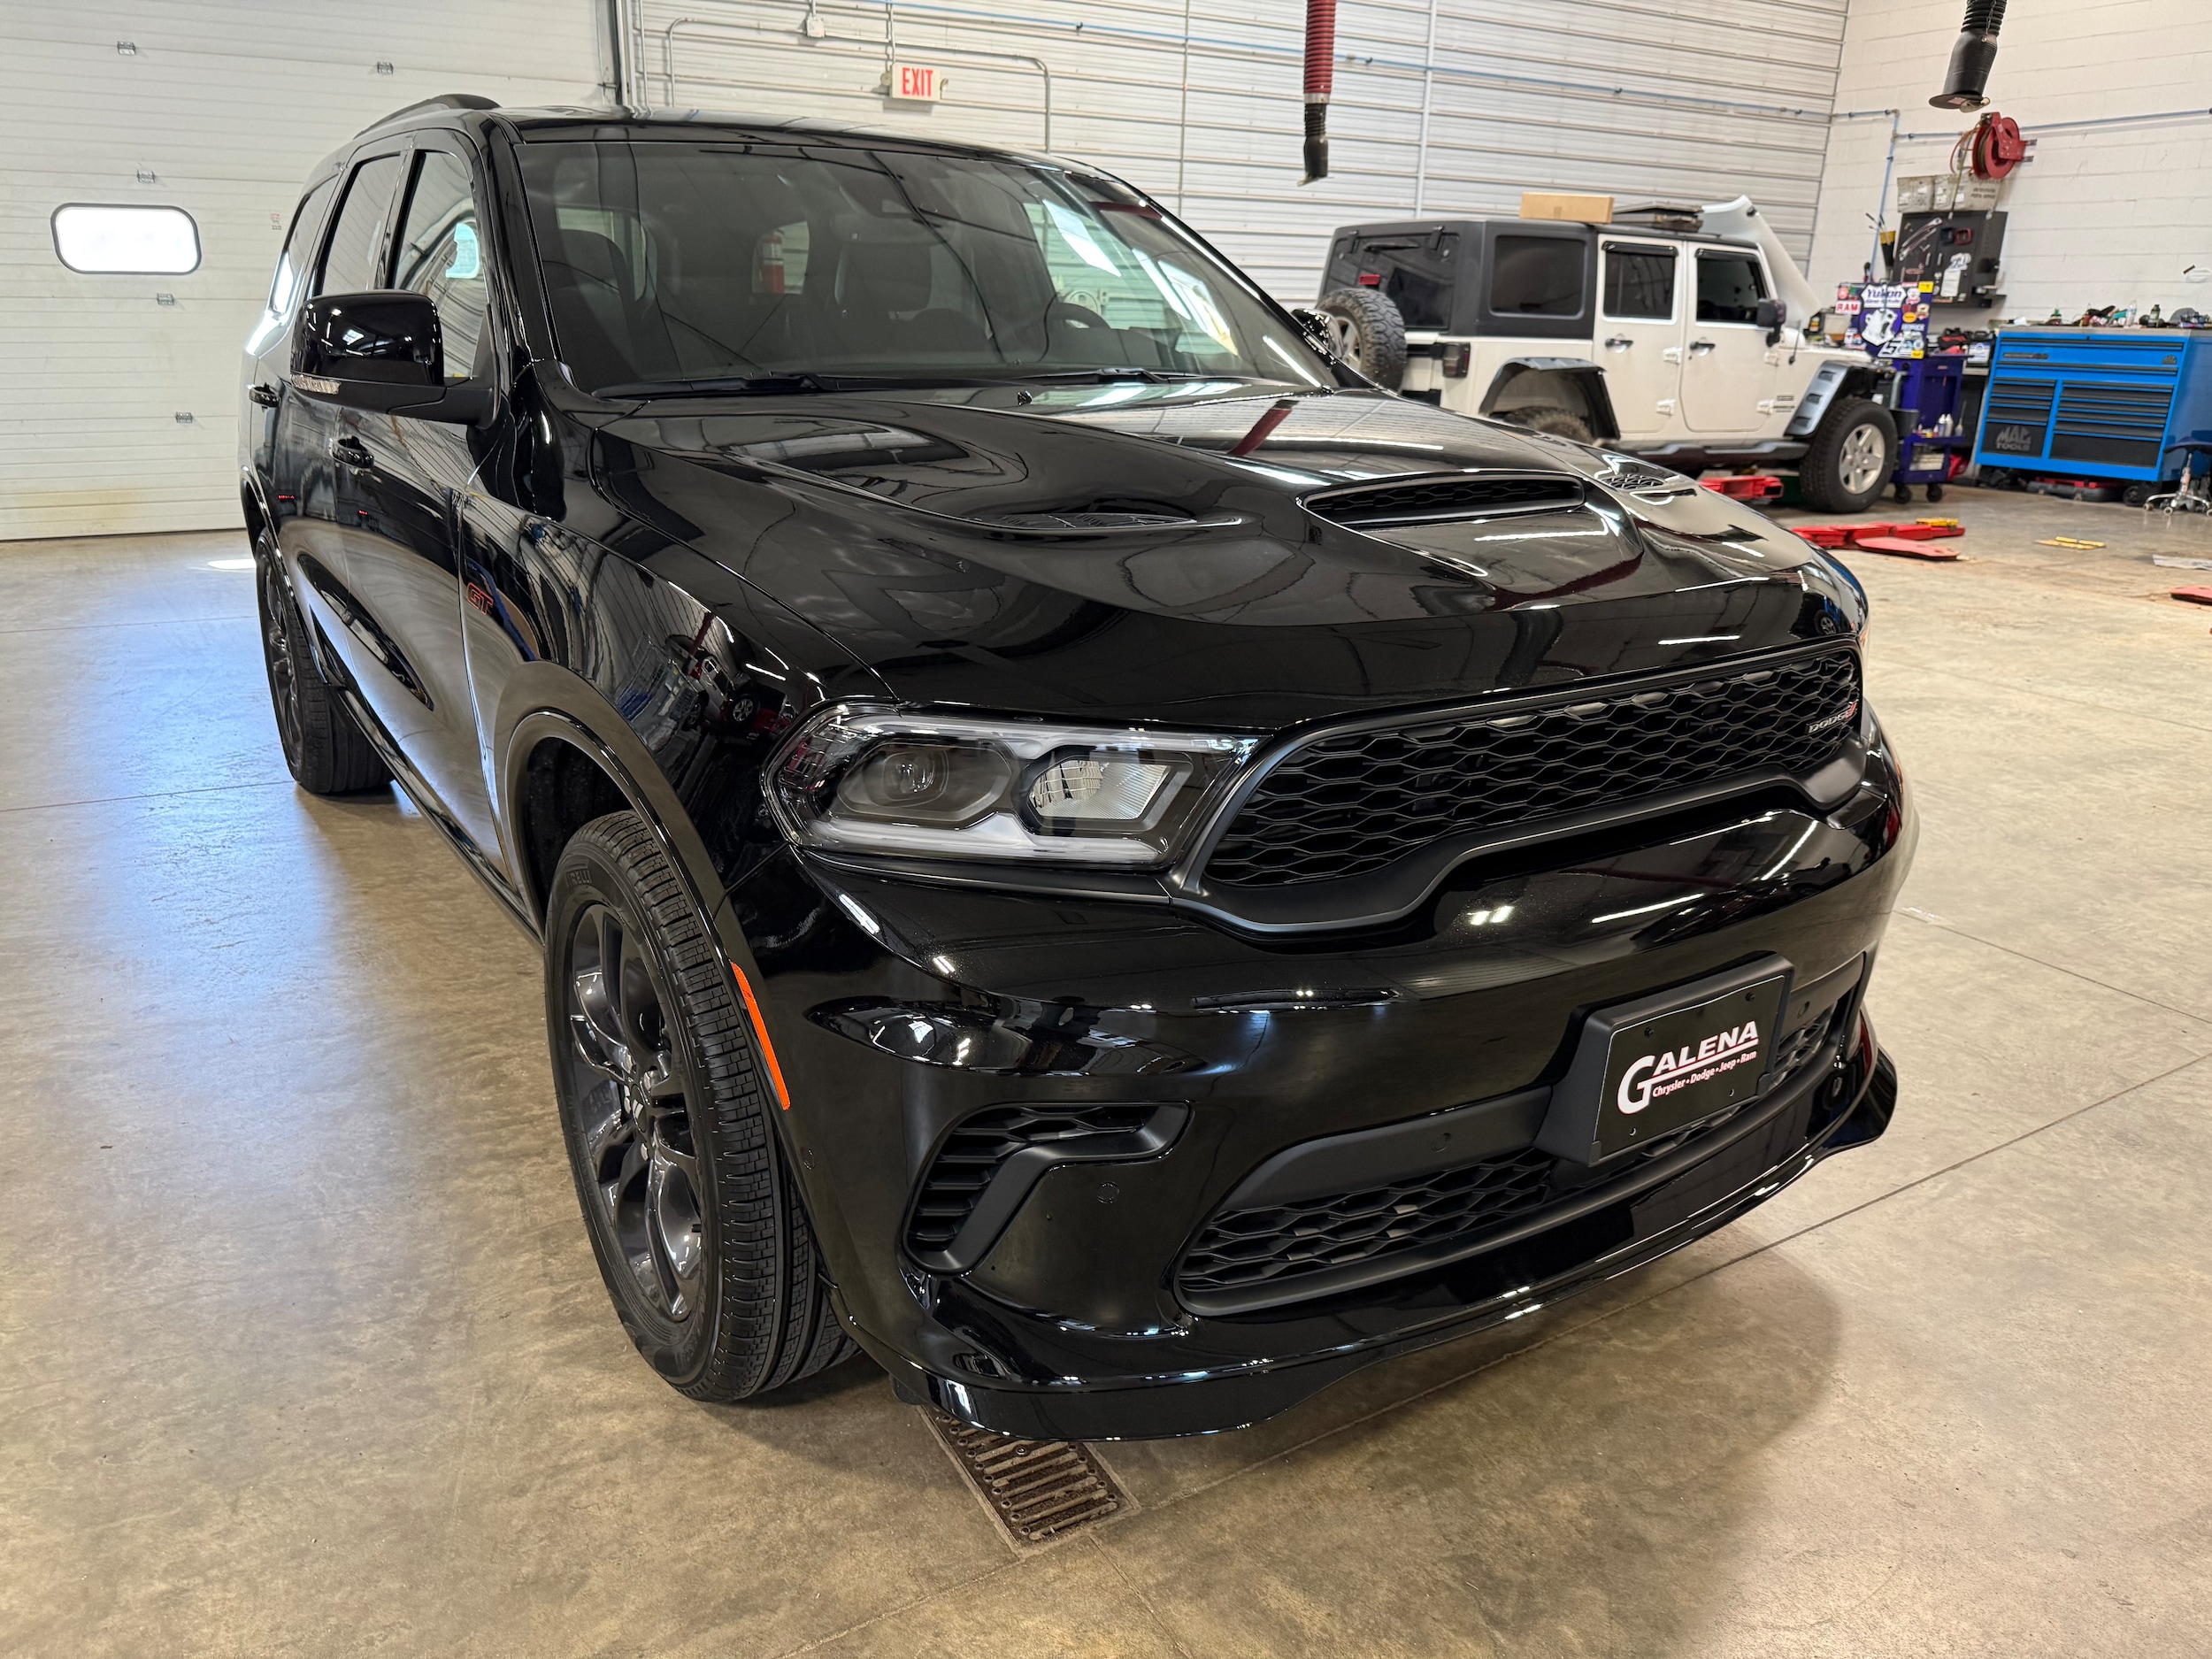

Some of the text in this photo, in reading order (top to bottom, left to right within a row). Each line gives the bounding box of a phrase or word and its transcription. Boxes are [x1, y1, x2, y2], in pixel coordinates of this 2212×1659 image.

[902, 67, 933, 97] EXIT
[1996, 425, 2032, 443] MAC
[466, 582, 494, 615] GT
[1808, 709, 1852, 733] DODGE
[1617, 1020, 1759, 1115] GALENA
[1652, 1050, 1757, 1098] Chrysler Dodge Jeep Ram
